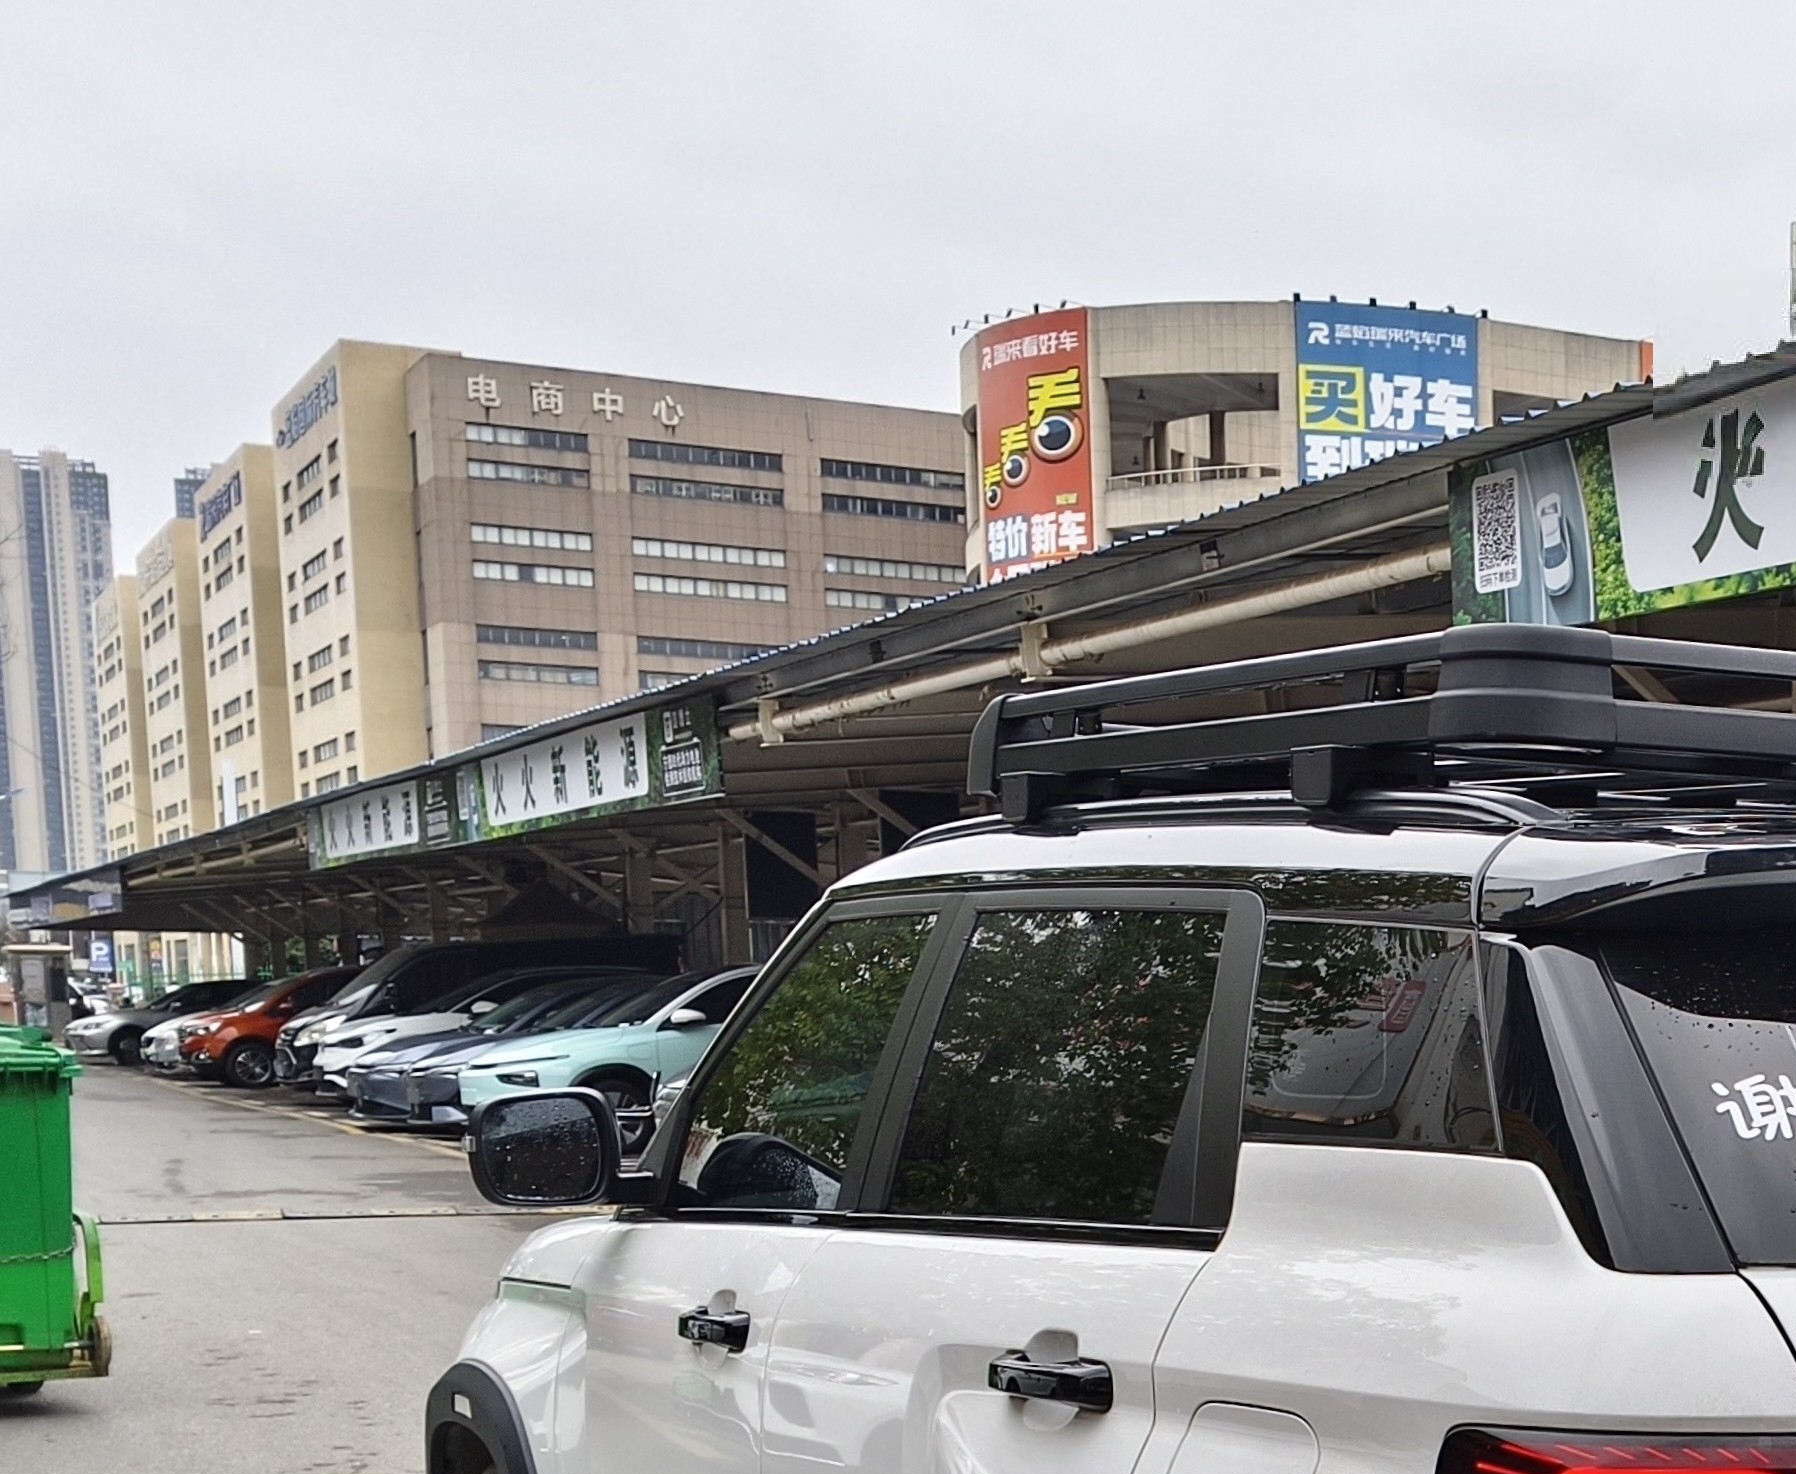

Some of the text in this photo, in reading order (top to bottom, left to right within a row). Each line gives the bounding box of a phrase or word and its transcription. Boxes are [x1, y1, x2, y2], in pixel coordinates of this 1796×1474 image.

[467, 373, 684, 427] 电商中心
[1305, 370, 1475, 439] 买好车
[492, 726, 639, 817] 火火新能源
